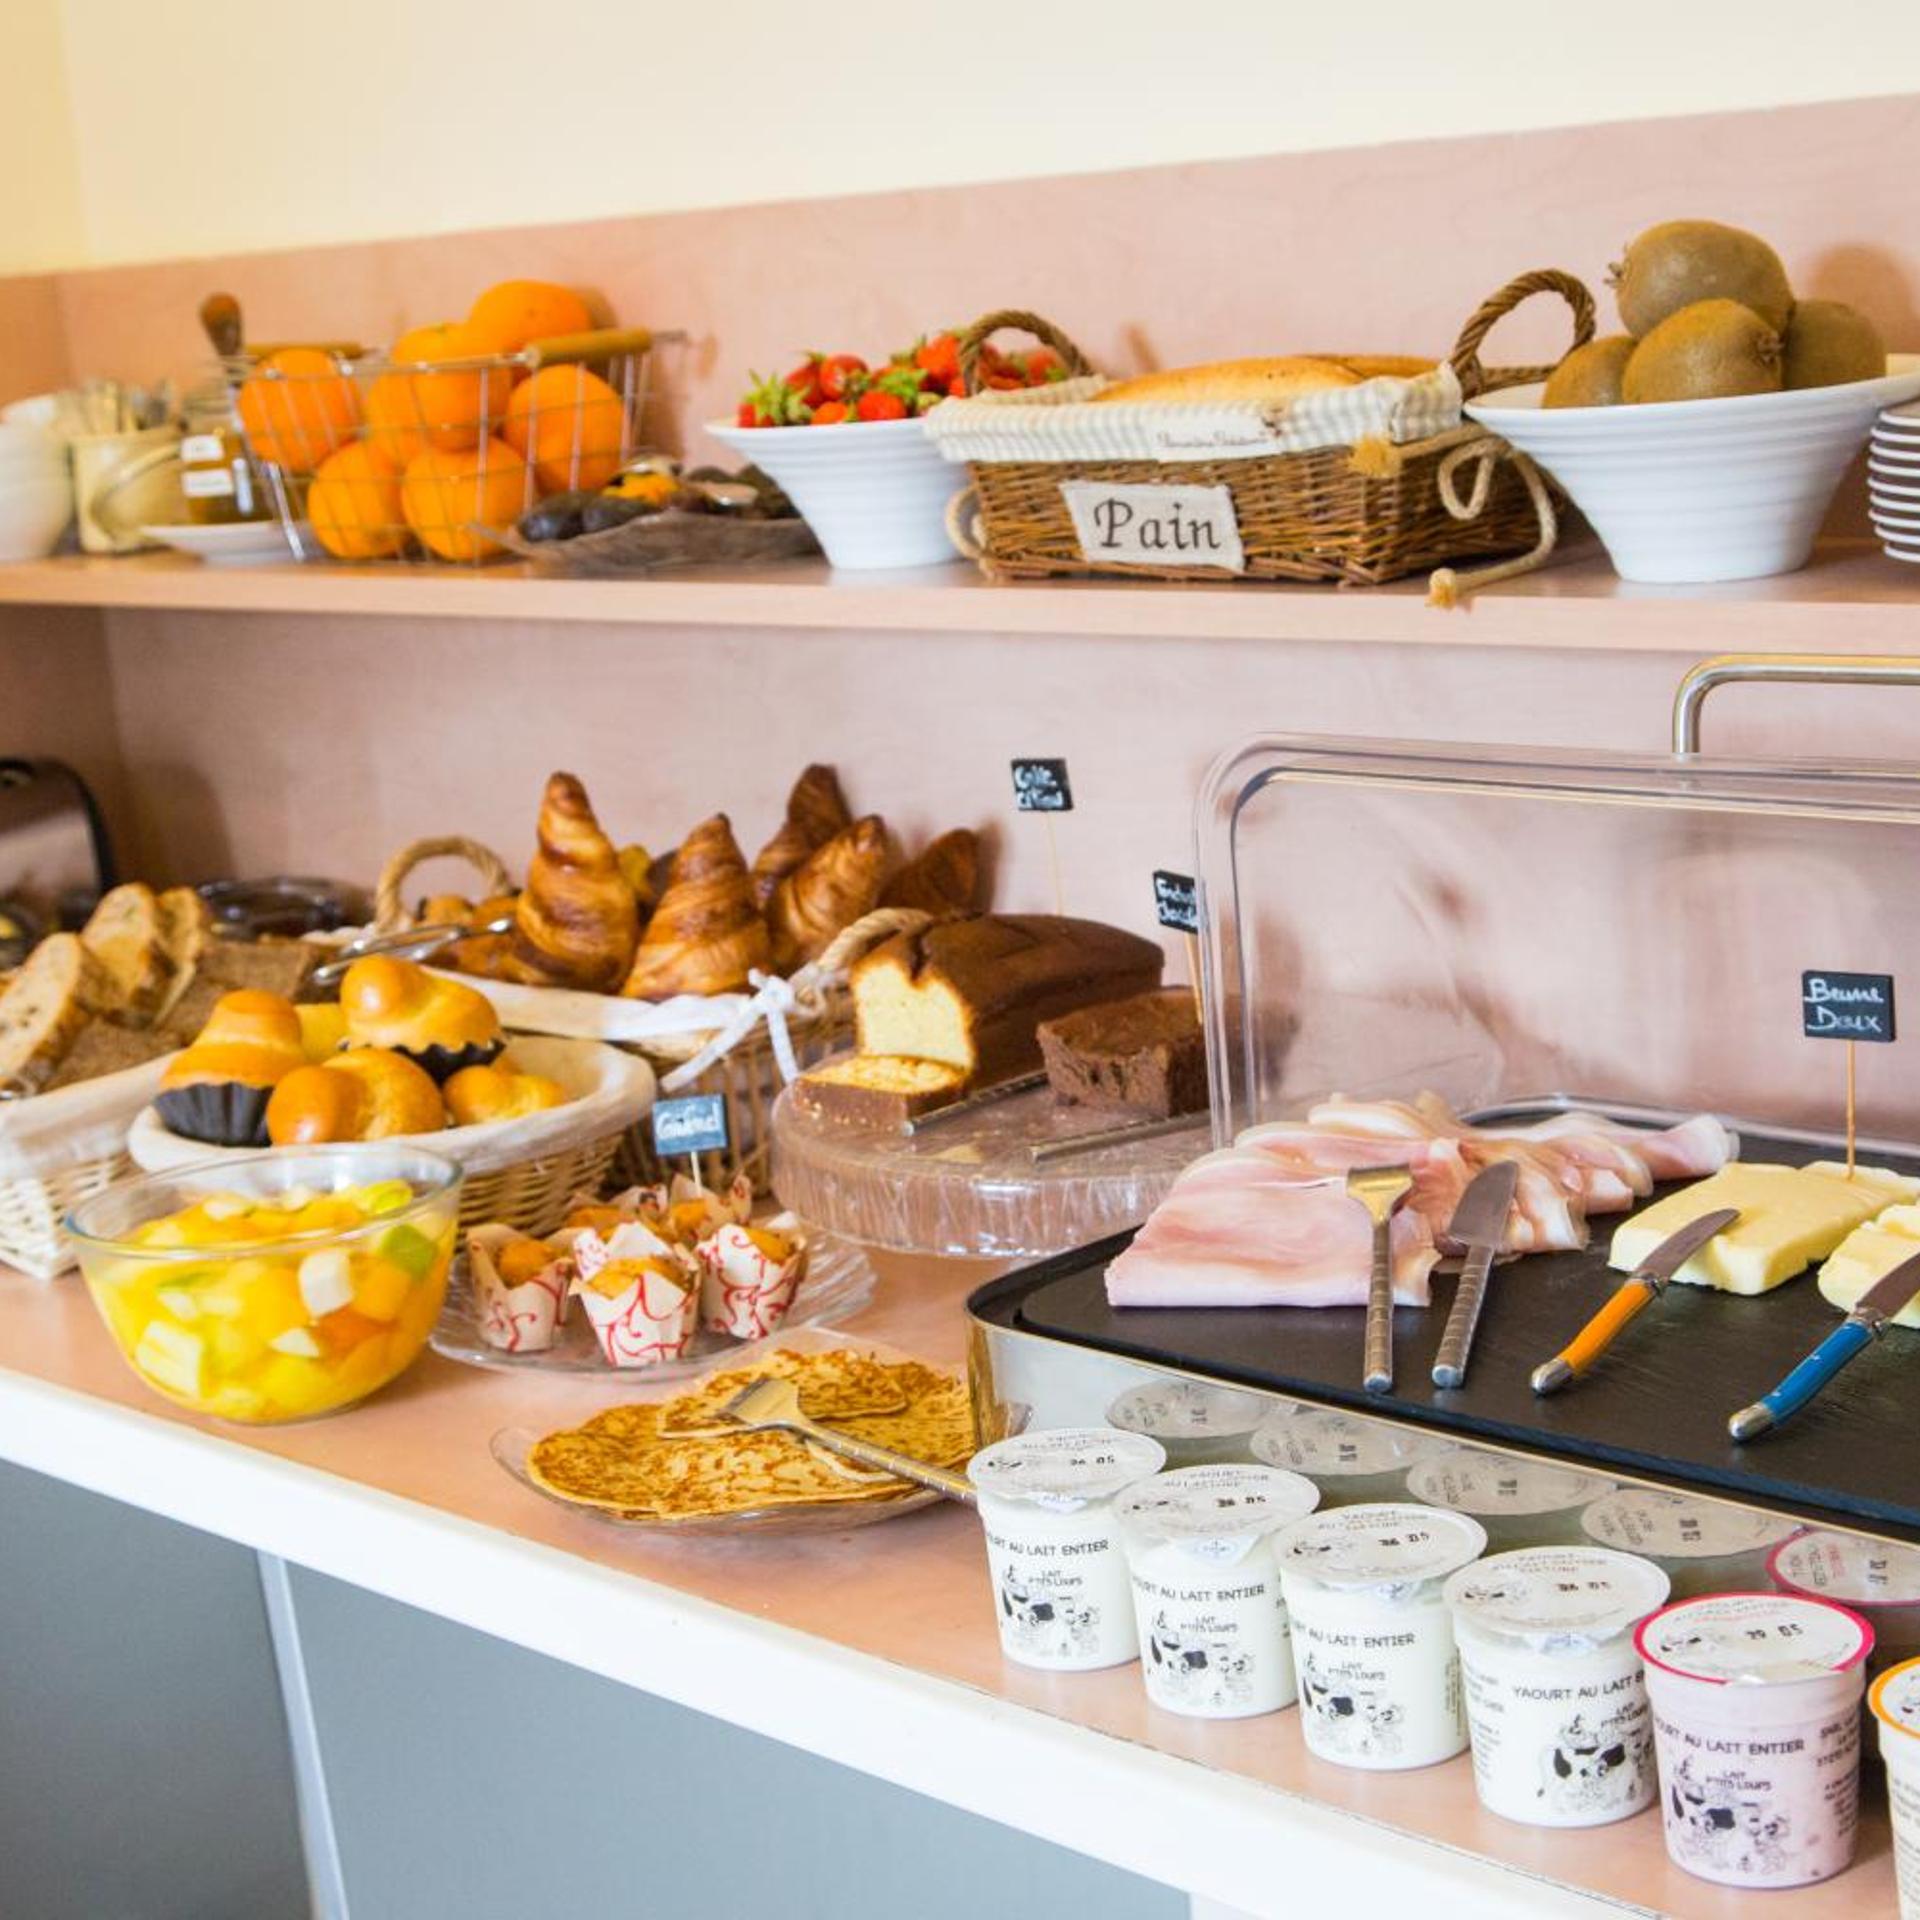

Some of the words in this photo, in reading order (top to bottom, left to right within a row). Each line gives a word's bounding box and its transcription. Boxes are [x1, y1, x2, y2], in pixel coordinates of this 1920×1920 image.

[1093, 498, 1221, 550] Pain
[1806, 1005, 1882, 1033] Doux
[1027, 1544, 1056, 1556] LAIT
[1061, 1538, 1109, 1557] ENTIER
[1179, 1589, 1212, 1602] LAIT
[1217, 1583, 1265, 1601] ENTIER
[1327, 1632, 1358, 1647] LAIT
[1363, 1632, 1416, 1649] ENTIER
[1513, 1687, 1572, 1701] YAOURT
[1578, 1685, 1599, 1698] AU
[1602, 1674, 1633, 1695] LAIT
[1706, 1739, 1741, 1754] LAIT
[1748, 1738, 1805, 1756] ENTIER
